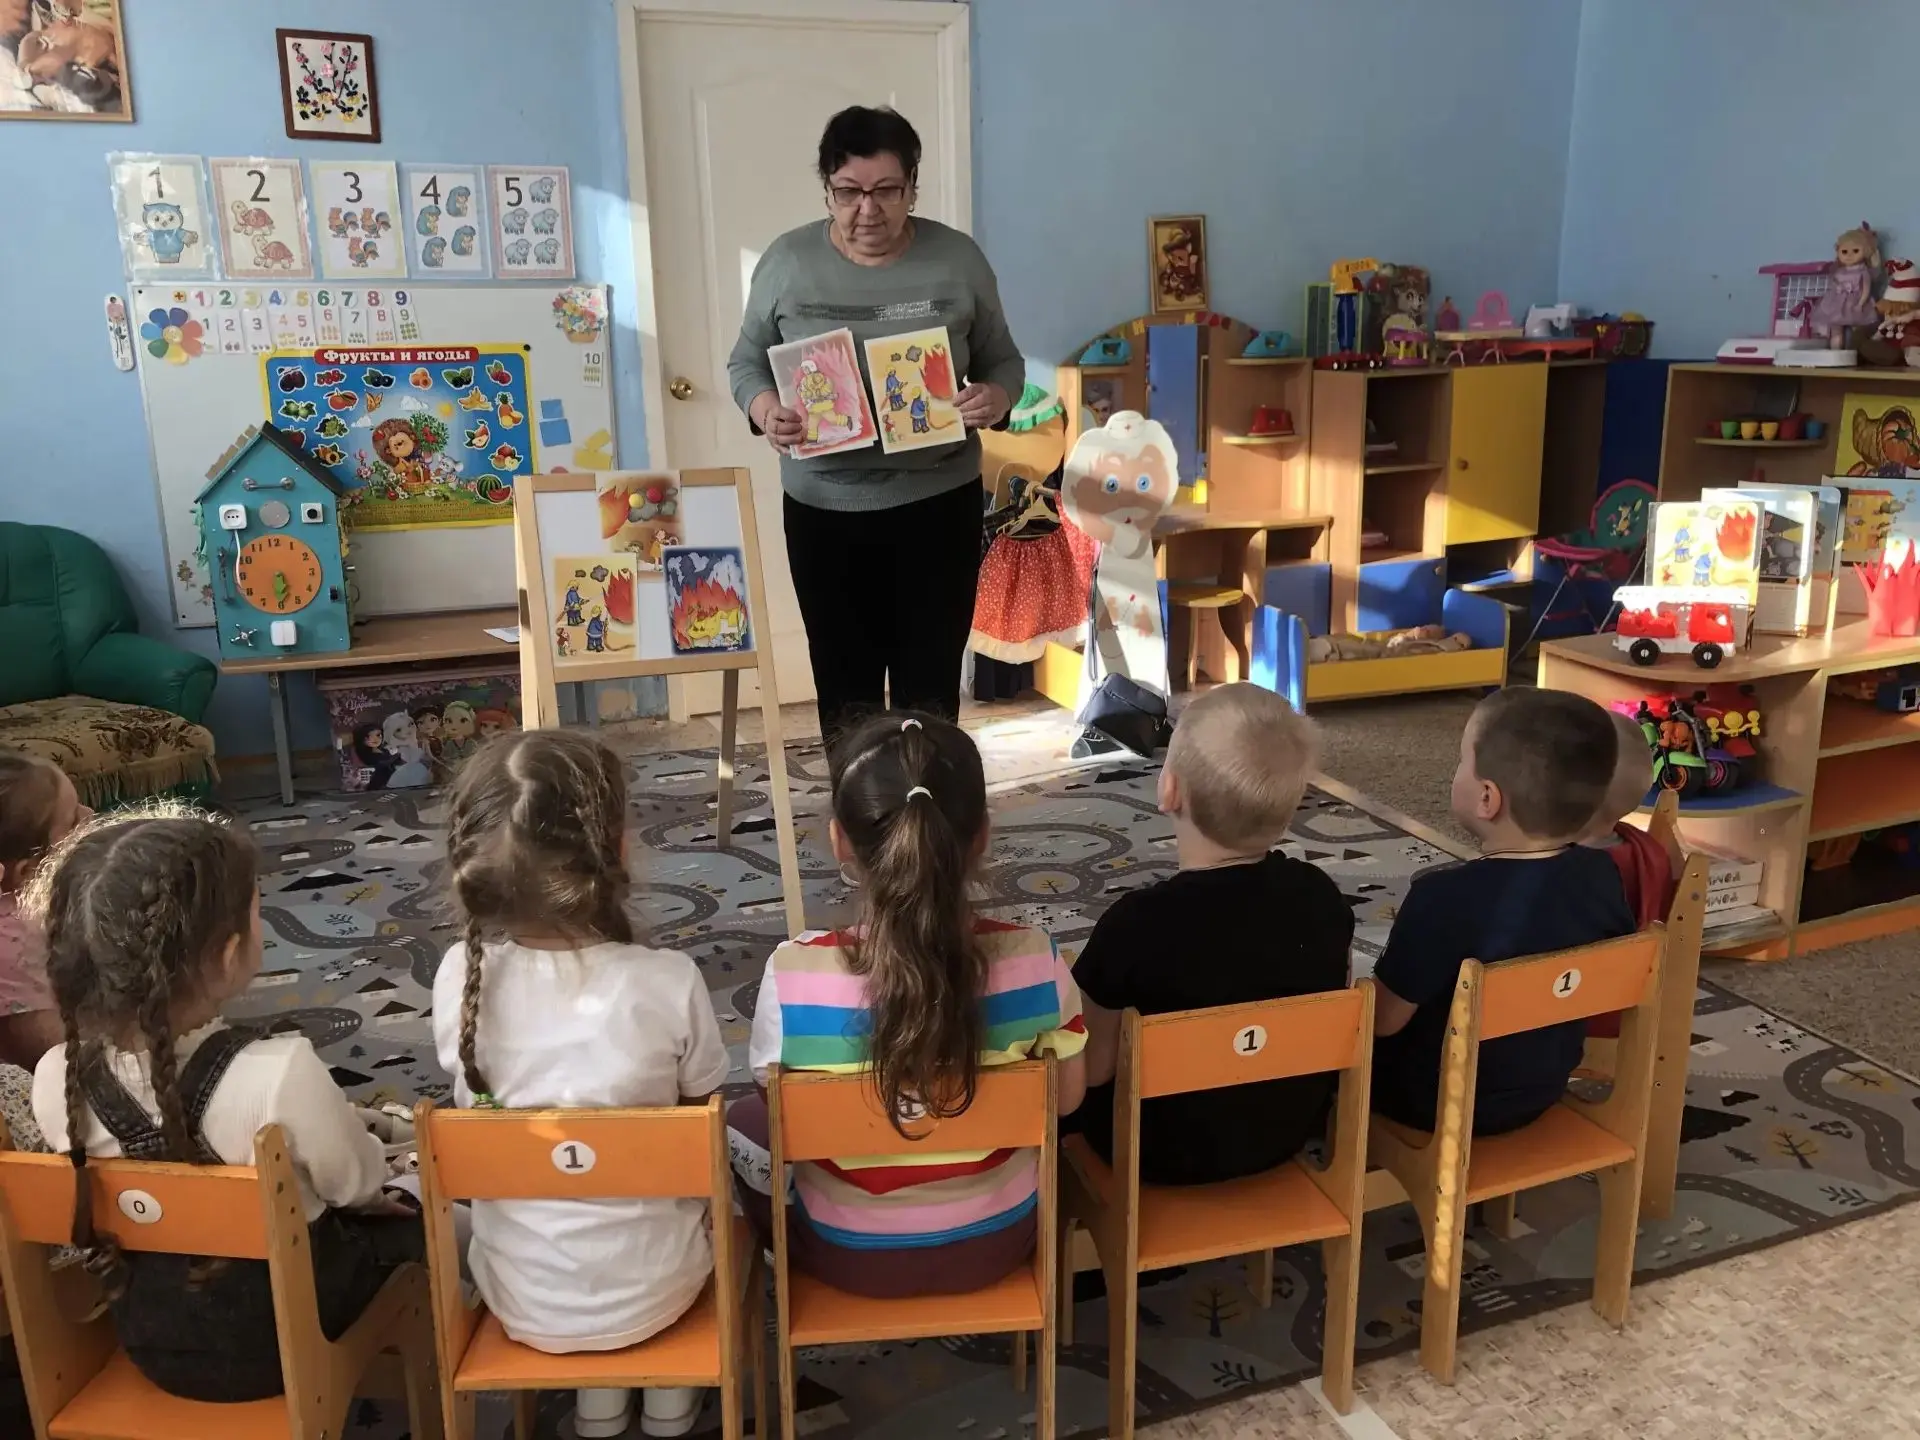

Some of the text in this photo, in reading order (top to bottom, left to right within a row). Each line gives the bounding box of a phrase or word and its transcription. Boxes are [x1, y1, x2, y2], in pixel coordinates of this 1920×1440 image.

[148, 166, 164, 198] 1
[246, 169, 270, 202] 2
[343, 171, 363, 203] 3
[420, 175, 441, 205] 4
[505, 177, 523, 207] 5
[195, 290, 205, 307] 1
[219, 289, 232, 306] 2
[268, 289, 281, 306] 4
[317, 290, 330, 306] 6
[341, 290, 353, 307] 7
[367, 290, 380, 307] 8
[395, 290, 407, 306] 9
[202, 308, 410, 331] 1 2 3 4 5 6 7 8 9
[323, 350, 471, 364] Фрукты и ягоды
[584, 352, 601, 365] 10
[251, 543, 263, 552] 11
[267, 538, 281, 548] 12
[289, 541, 295, 551] 1
[302, 552, 310, 562] 2
[309, 568, 316, 577] 3
[306, 584, 313, 593] 4
[260, 598, 267, 607] 7
[277, 601, 285, 610] 6
[294, 596, 302, 605] 5
[1559, 971, 1572, 993] 1
[1243, 1029, 1258, 1052] 1
[563, 1145, 584, 1169] 1
